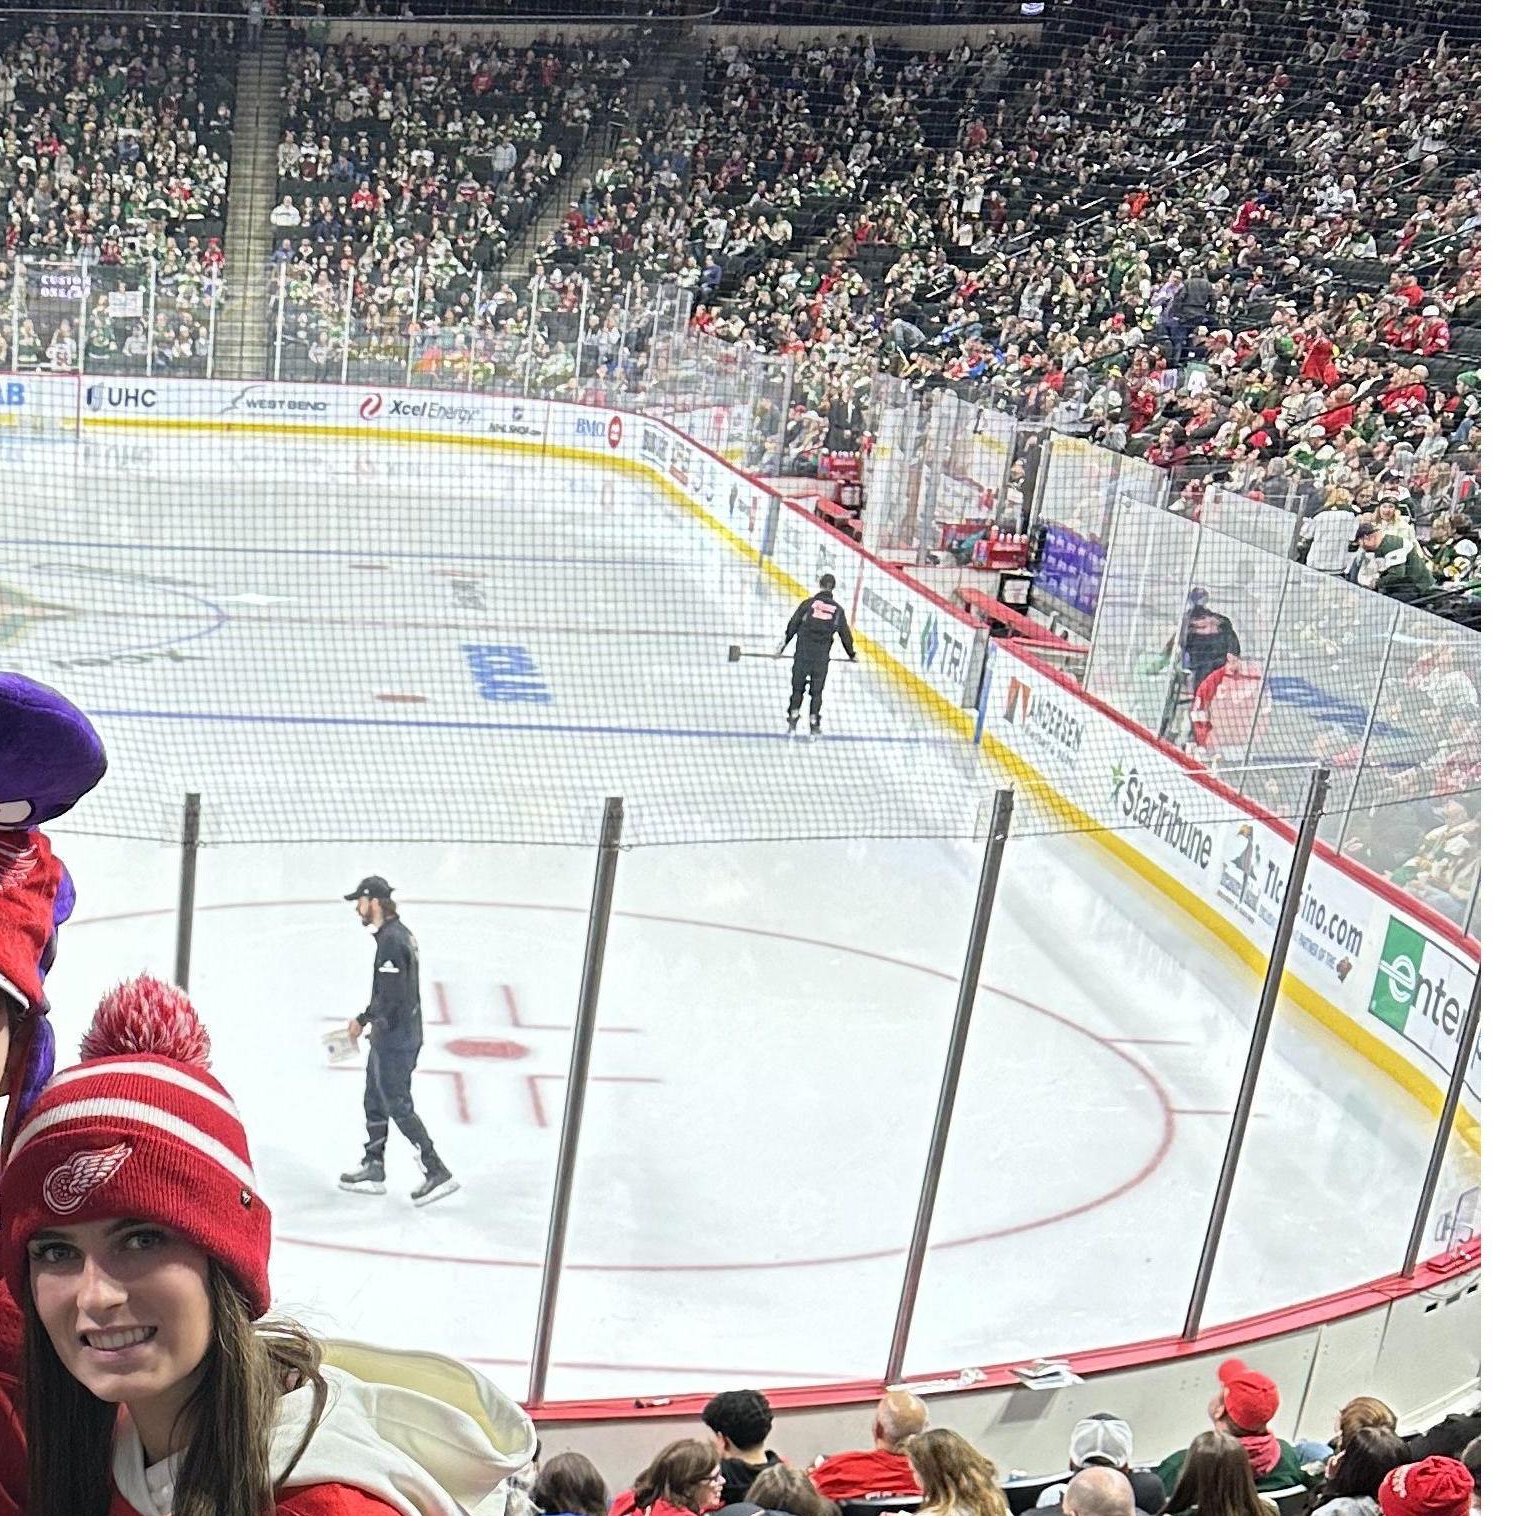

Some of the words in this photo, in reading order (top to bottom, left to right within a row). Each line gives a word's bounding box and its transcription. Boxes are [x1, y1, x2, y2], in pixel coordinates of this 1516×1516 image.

[107, 387, 157, 408] UHC
[576, 417, 606, 438] BMO
[941, 631, 968, 685] TRI
[1028, 696, 1084, 752] ANDERSEN
